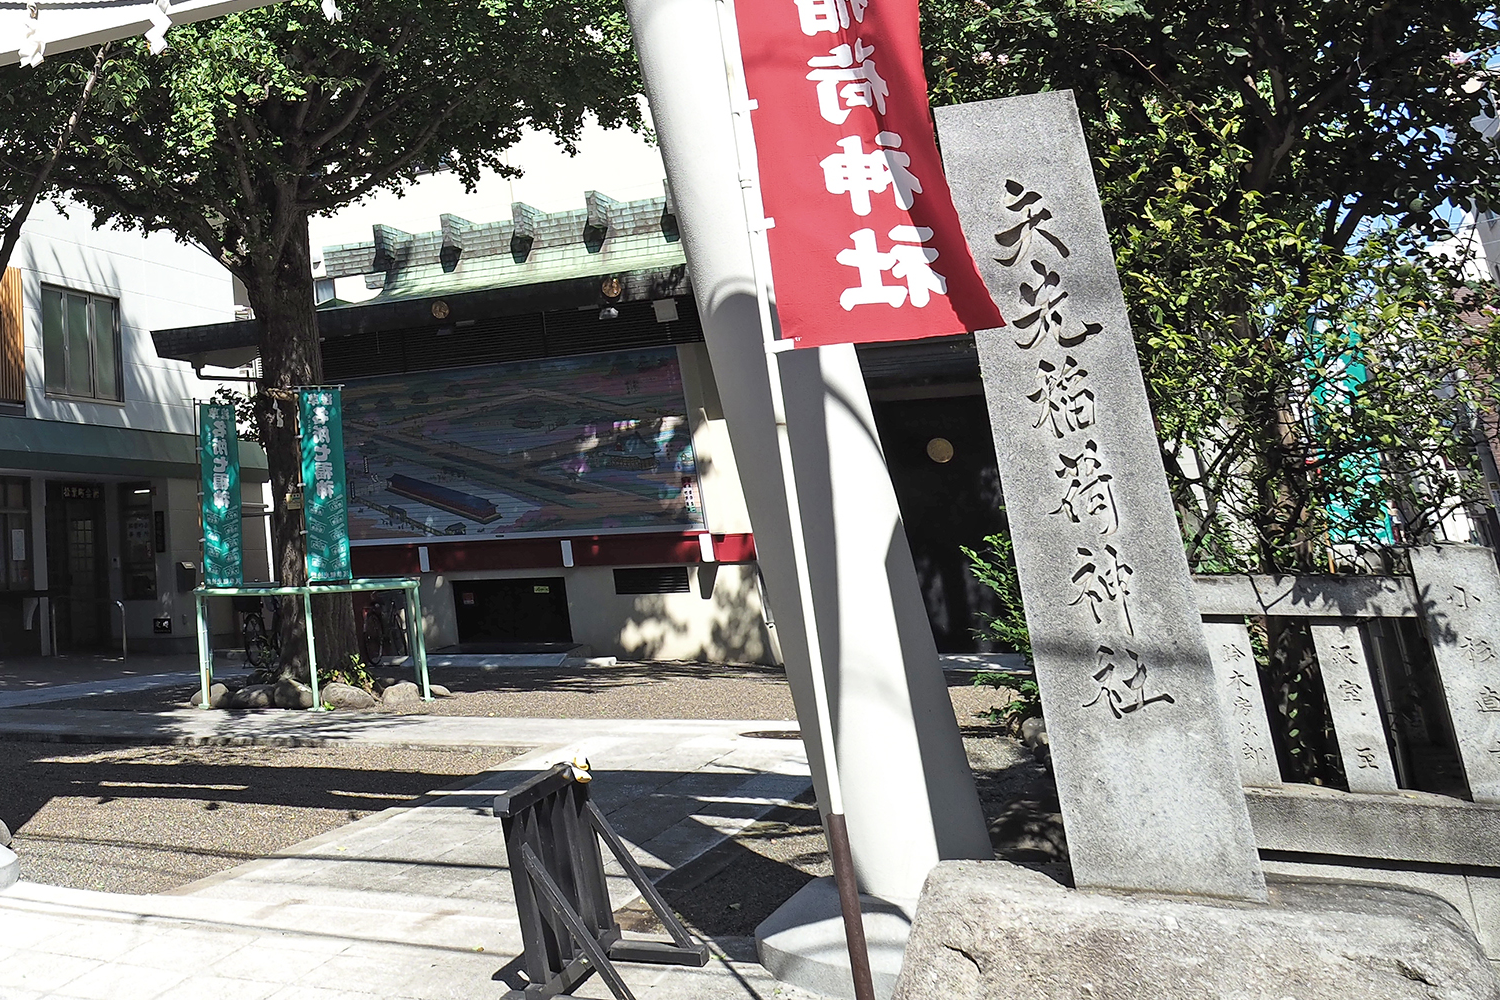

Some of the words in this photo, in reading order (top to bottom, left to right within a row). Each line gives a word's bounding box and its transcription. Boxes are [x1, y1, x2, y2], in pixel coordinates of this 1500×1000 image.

[993, 178, 1176, 719] 矢先稲荷神社
